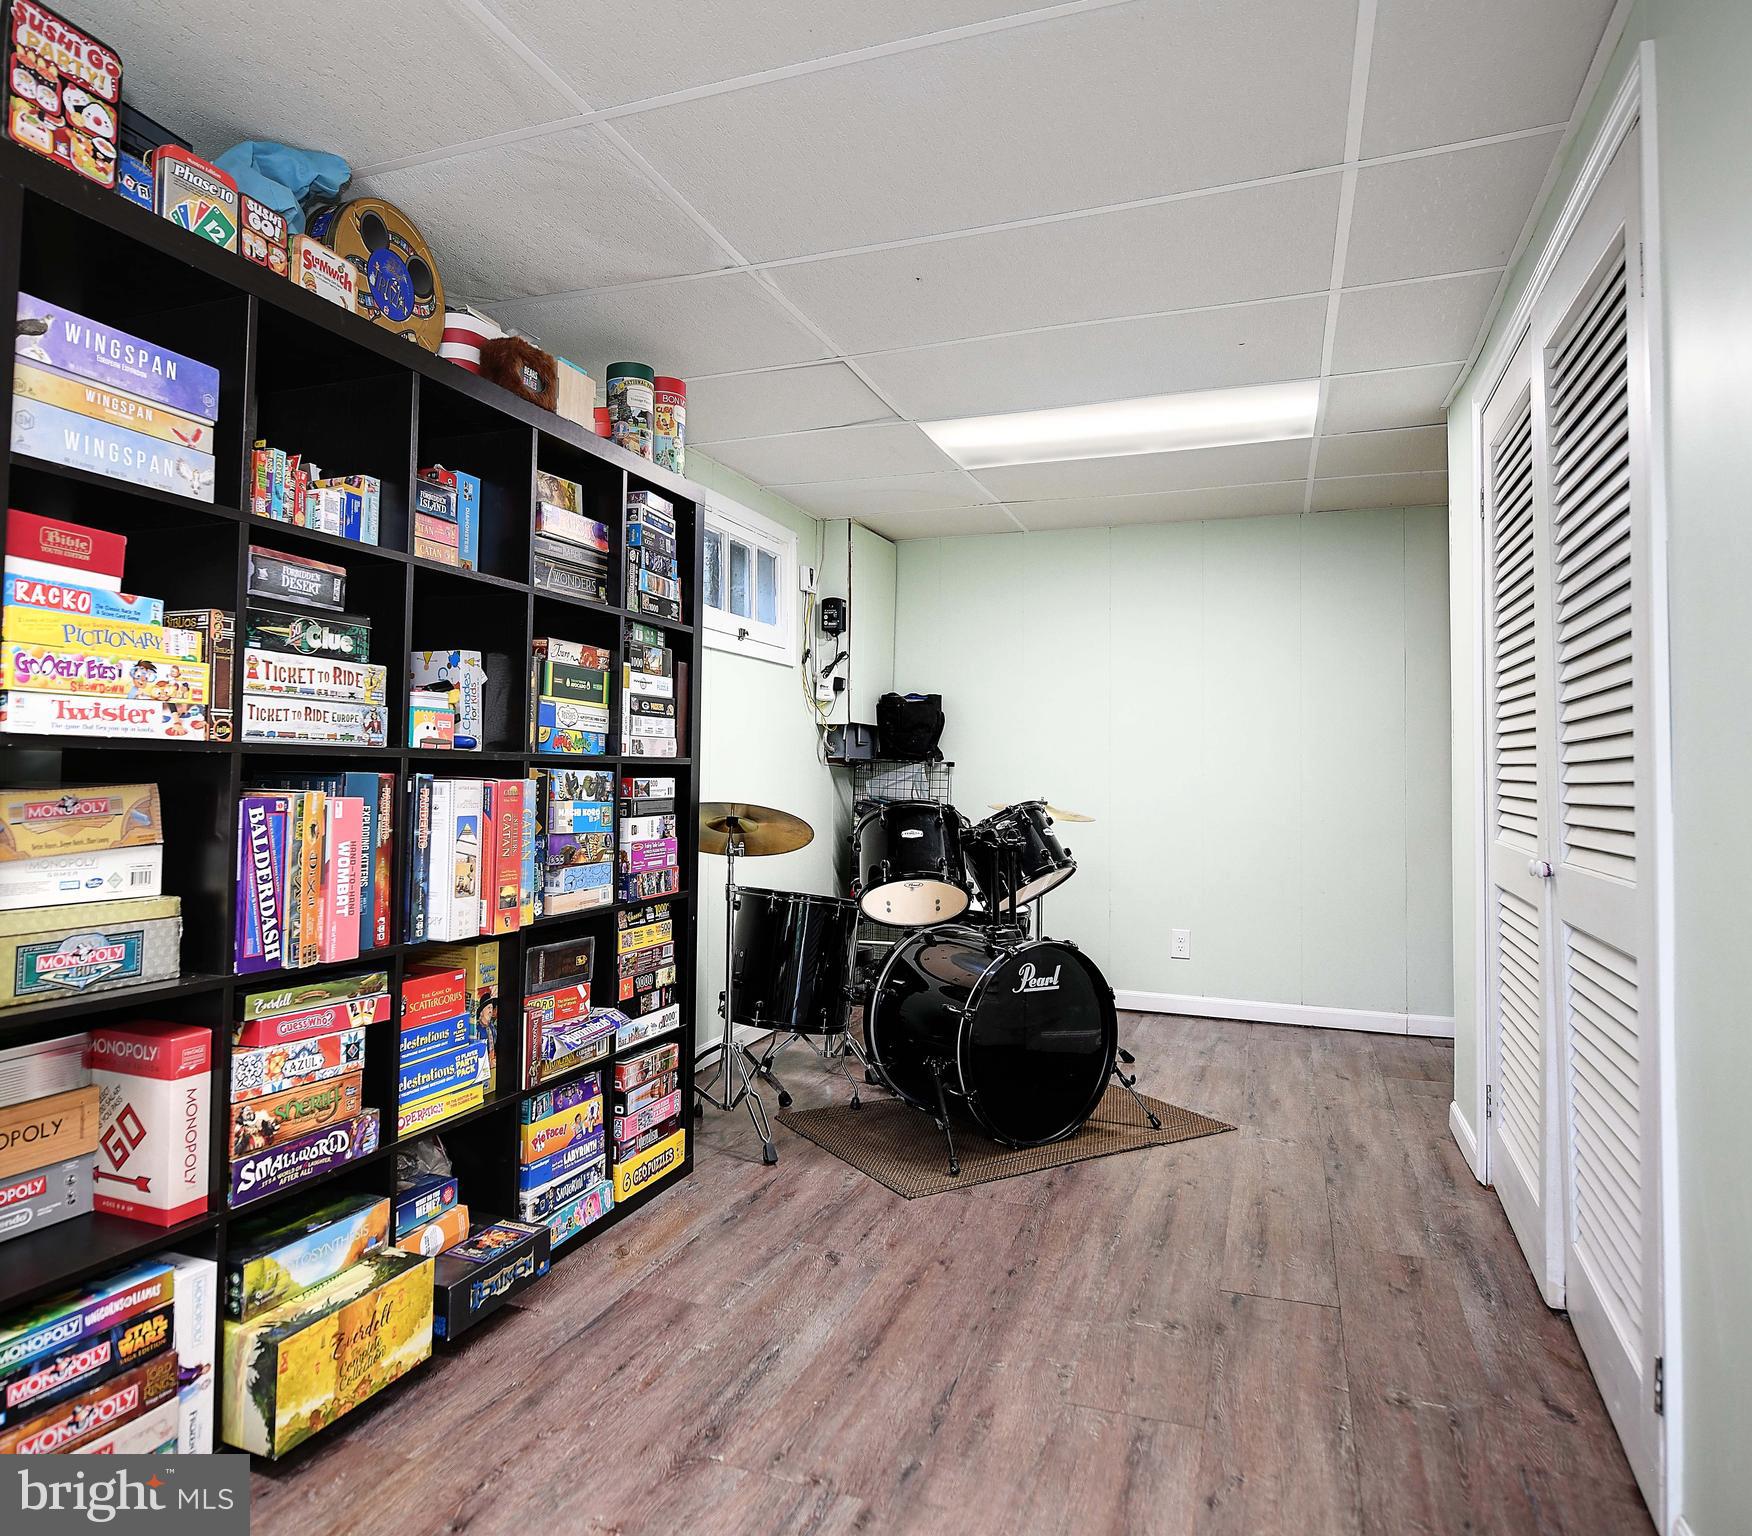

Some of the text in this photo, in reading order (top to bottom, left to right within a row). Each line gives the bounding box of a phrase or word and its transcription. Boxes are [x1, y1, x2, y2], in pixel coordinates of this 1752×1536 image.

[25, 31, 107, 91] PARTY!
[173, 162, 218, 196] Phase
[218, 187, 235, 204] 10
[203, 219, 226, 243] 12
[248, 212, 281, 242] GO!
[64, 320, 178, 381] WINGSPAN
[85, 388, 154, 422] WINGSPAN
[662, 394, 680, 404] BON
[64, 429, 174, 478] WINGSPAN
[419, 498, 447, 514] ISLAND
[46, 529, 88, 550] Bible
[419, 544, 442, 559] CATAN
[281, 575, 322, 595] DESERT
[282, 565, 322, 582] FORBIDDEN
[552, 570, 597, 592] WONDERS
[63, 624, 163, 650] PICTIONARY
[305, 624, 354, 653] Clue
[87, 659, 116, 680] EYES
[261, 659, 364, 689] TICKET TO RIDE
[630, 656, 643, 668] 1000
[51, 699, 156, 724] Twister
[463, 672, 471, 730] Charades
[247, 703, 361, 725] TICKET TO RIDE EUROPE
[28, 799, 108, 818] MONOPOLY
[418, 786, 430, 850] PANDEMIC
[360, 805, 371, 888] EXPLODING KITTENS
[501, 812, 512, 858] CATAN
[521, 808, 533, 861] CATAN
[28, 857, 97, 870] MONOPOLY
[248, 804, 281, 962] BALDERDASH
[335, 840, 351, 918] WOMBAT
[660, 921, 672, 932] 500
[37, 945, 124, 970] MONOPOLY
[635, 973, 654, 988] 1000
[1012, 962, 1062, 994] Pearl
[408, 991, 463, 1014] SCATTERGORIES
[456, 1019, 464, 1030] 6
[91, 1038, 159, 1062] MONOPOLY
[455, 1055, 479, 1070] PARTY
[461, 1049, 479, 1061] PLAYER
[289, 1055, 319, 1074] AZUL
[456, 1063, 476, 1078] PACK
[398, 1102, 445, 1131] OPERATION
[99, 1102, 147, 1172] GO
[184, 1087, 198, 1185] MONOPOLY
[545, 1123, 567, 1140] Face!
[562, 1139, 598, 1165] LABYRINTH
[279, 1172, 300, 1186] AFTER
[622, 1172, 632, 1192] 6
[117, 1322, 169, 1358] WARS
[124, 1314, 168, 1341] STAR
[332, 1300, 394, 1360] Everdell
[9, 1343, 110, 1405] MONOPOLY
[19, 1385, 138, 1455] MONOPOLY
